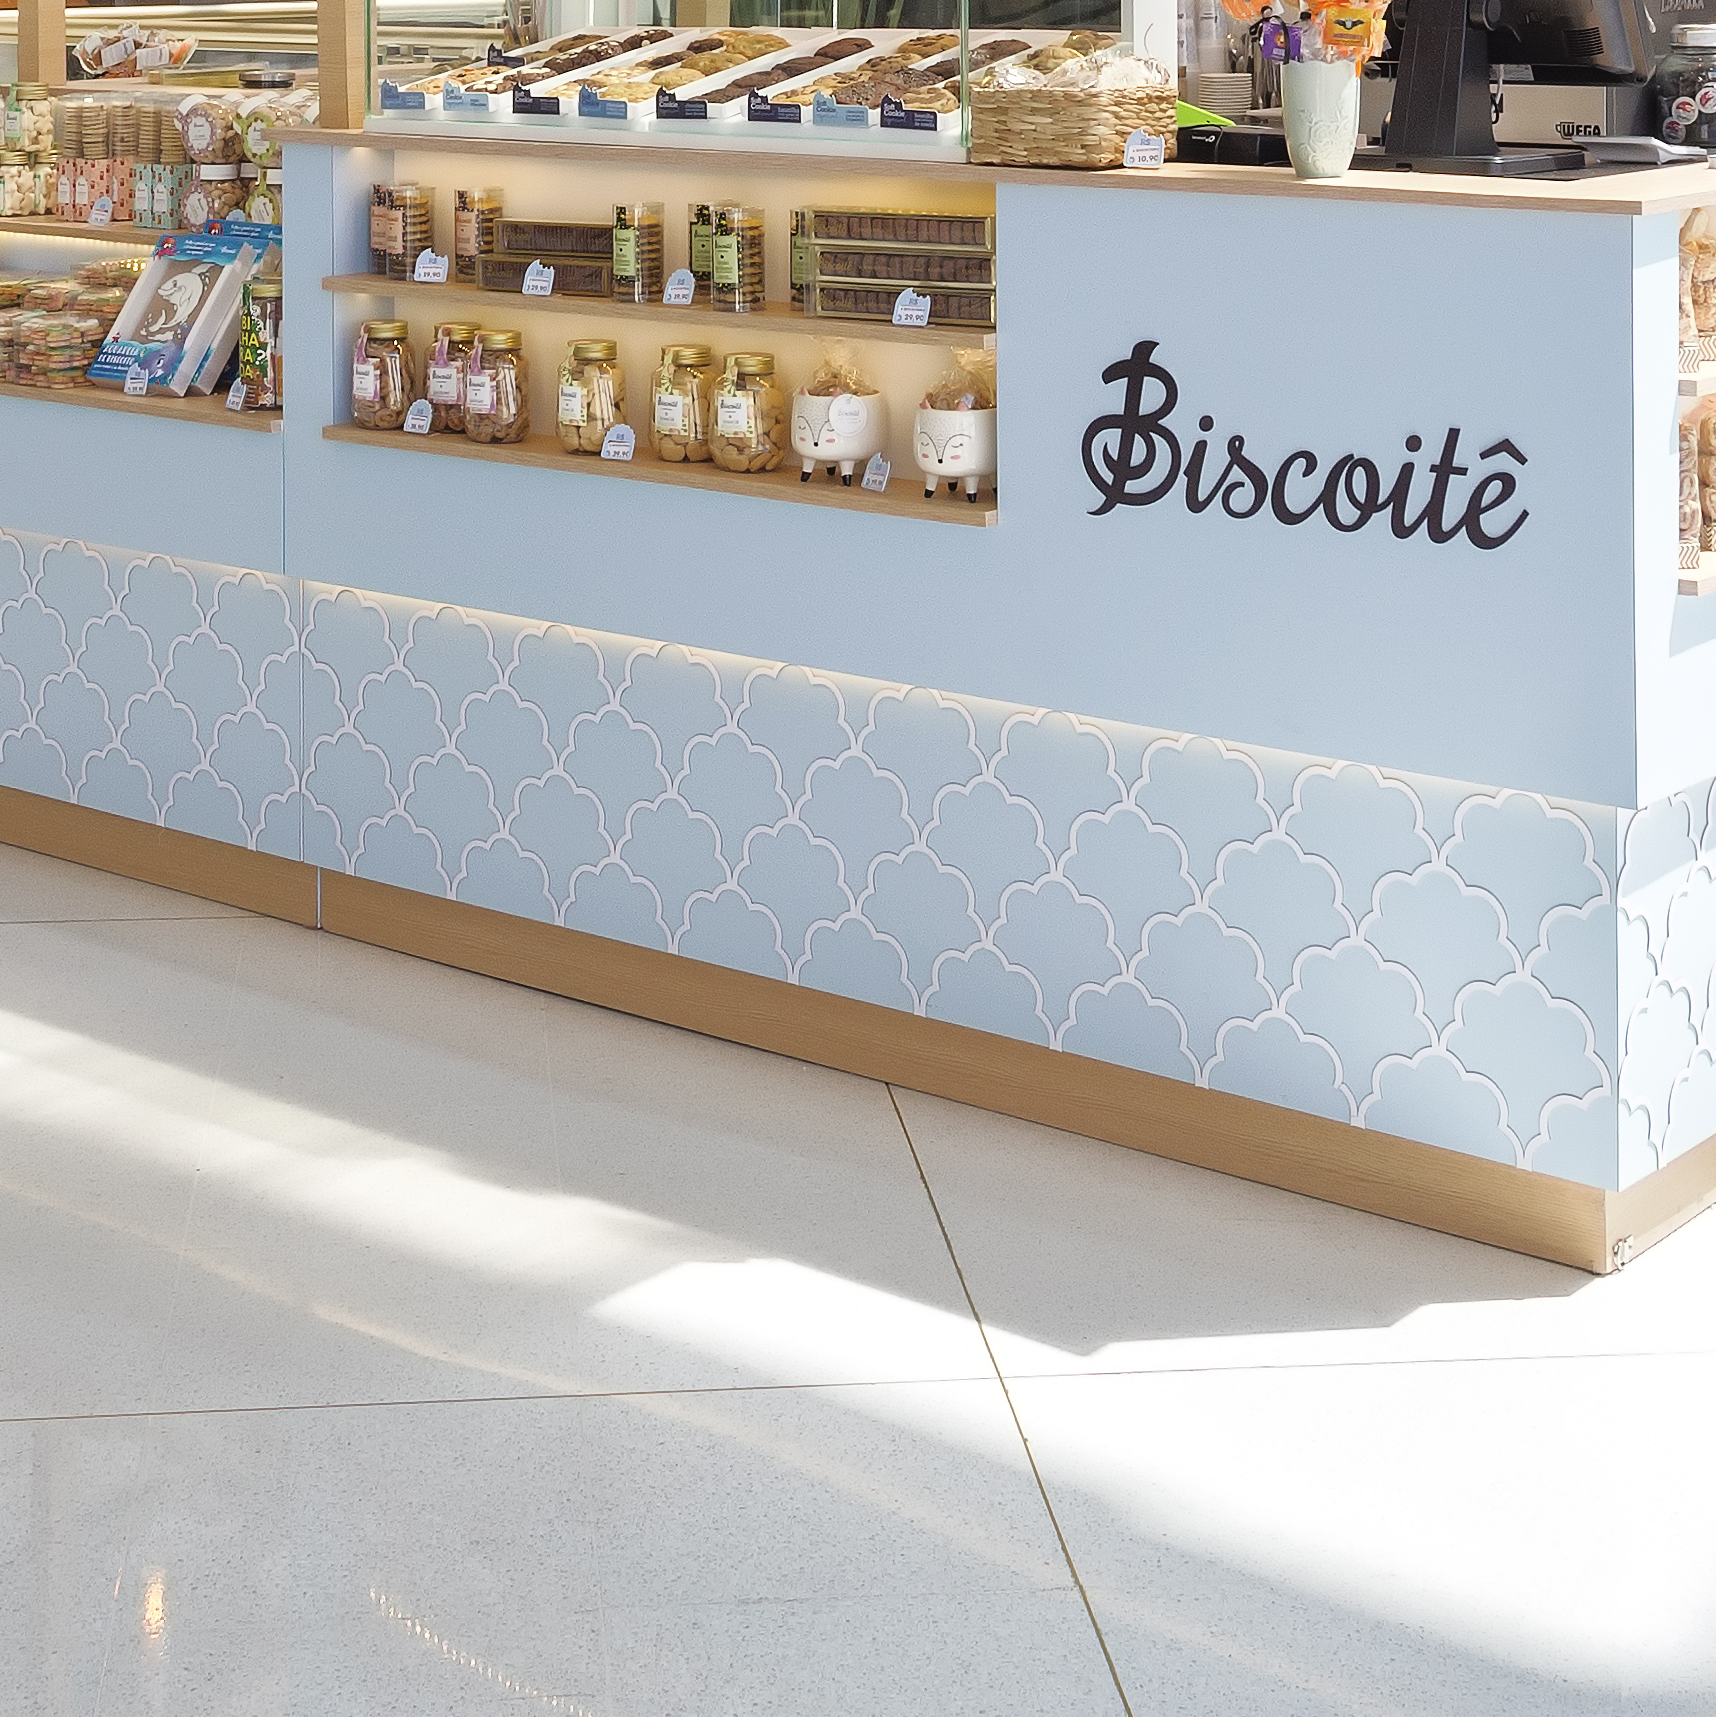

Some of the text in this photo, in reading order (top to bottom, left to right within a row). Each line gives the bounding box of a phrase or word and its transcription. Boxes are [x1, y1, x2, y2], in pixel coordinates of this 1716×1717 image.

[750, 102, 771, 110] Cookie
[883, 109, 906, 117] Cookie
[1563, 124, 1601, 136] WEGA
[240, 334, 260, 348] HA
[1081, 340, 1530, 550] Biscoitê
